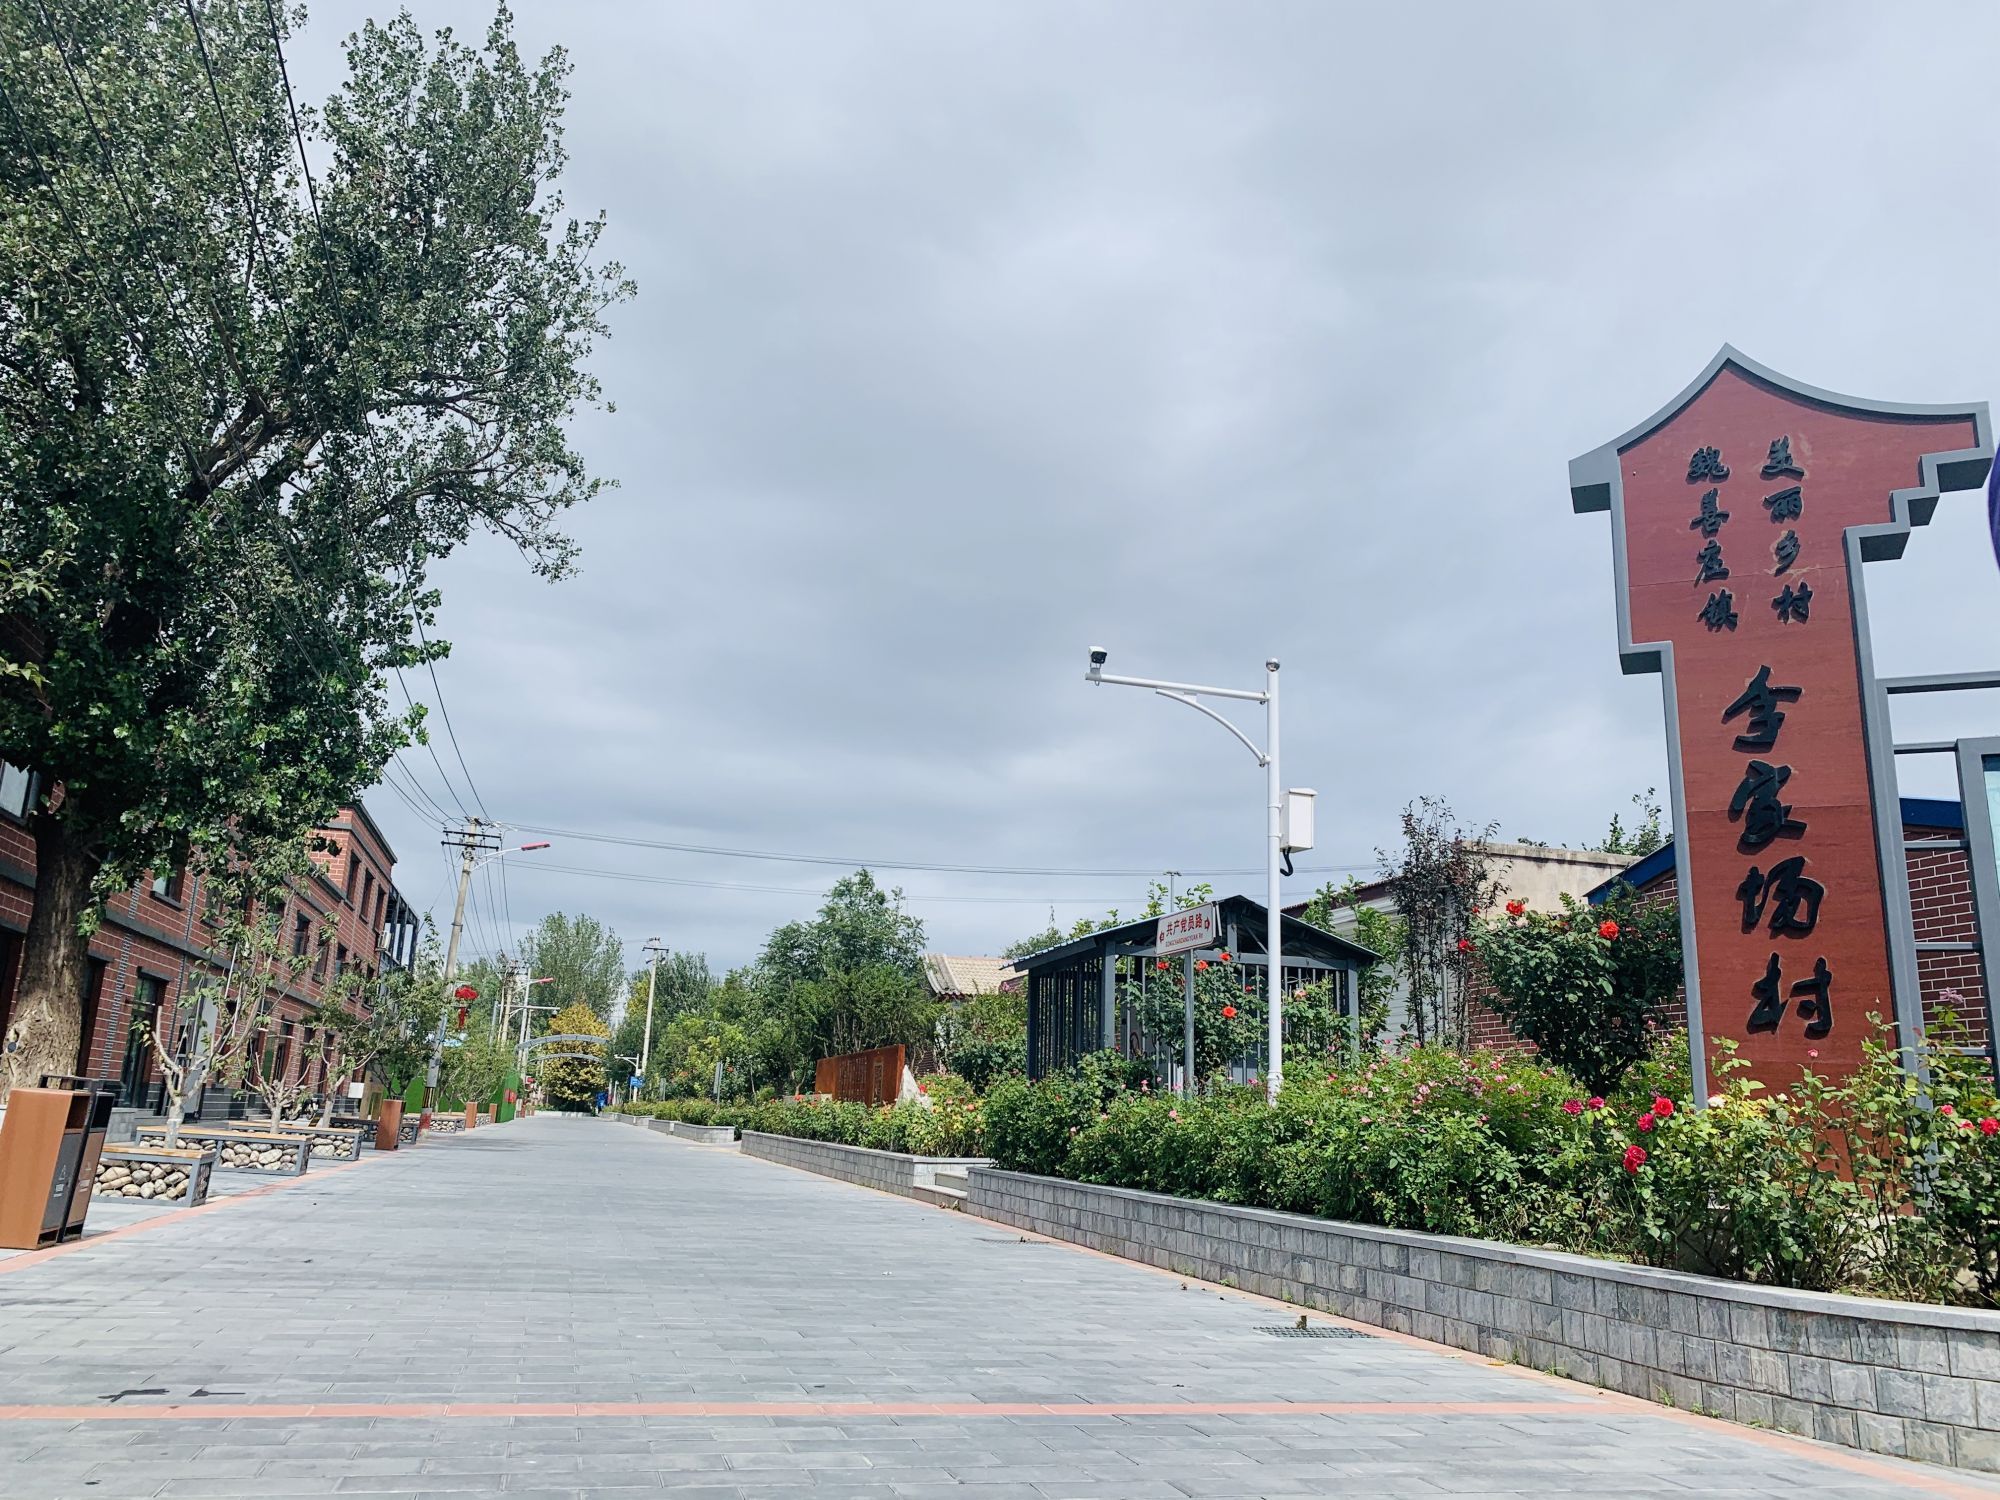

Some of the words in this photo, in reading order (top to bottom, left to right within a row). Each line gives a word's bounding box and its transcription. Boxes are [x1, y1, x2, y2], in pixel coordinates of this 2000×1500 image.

[1686, 445, 1738, 632] 魏善庄镇
[1760, 435, 1814, 625] 美丽乡村
[1166, 912, 1202, 937] 共产党员路
